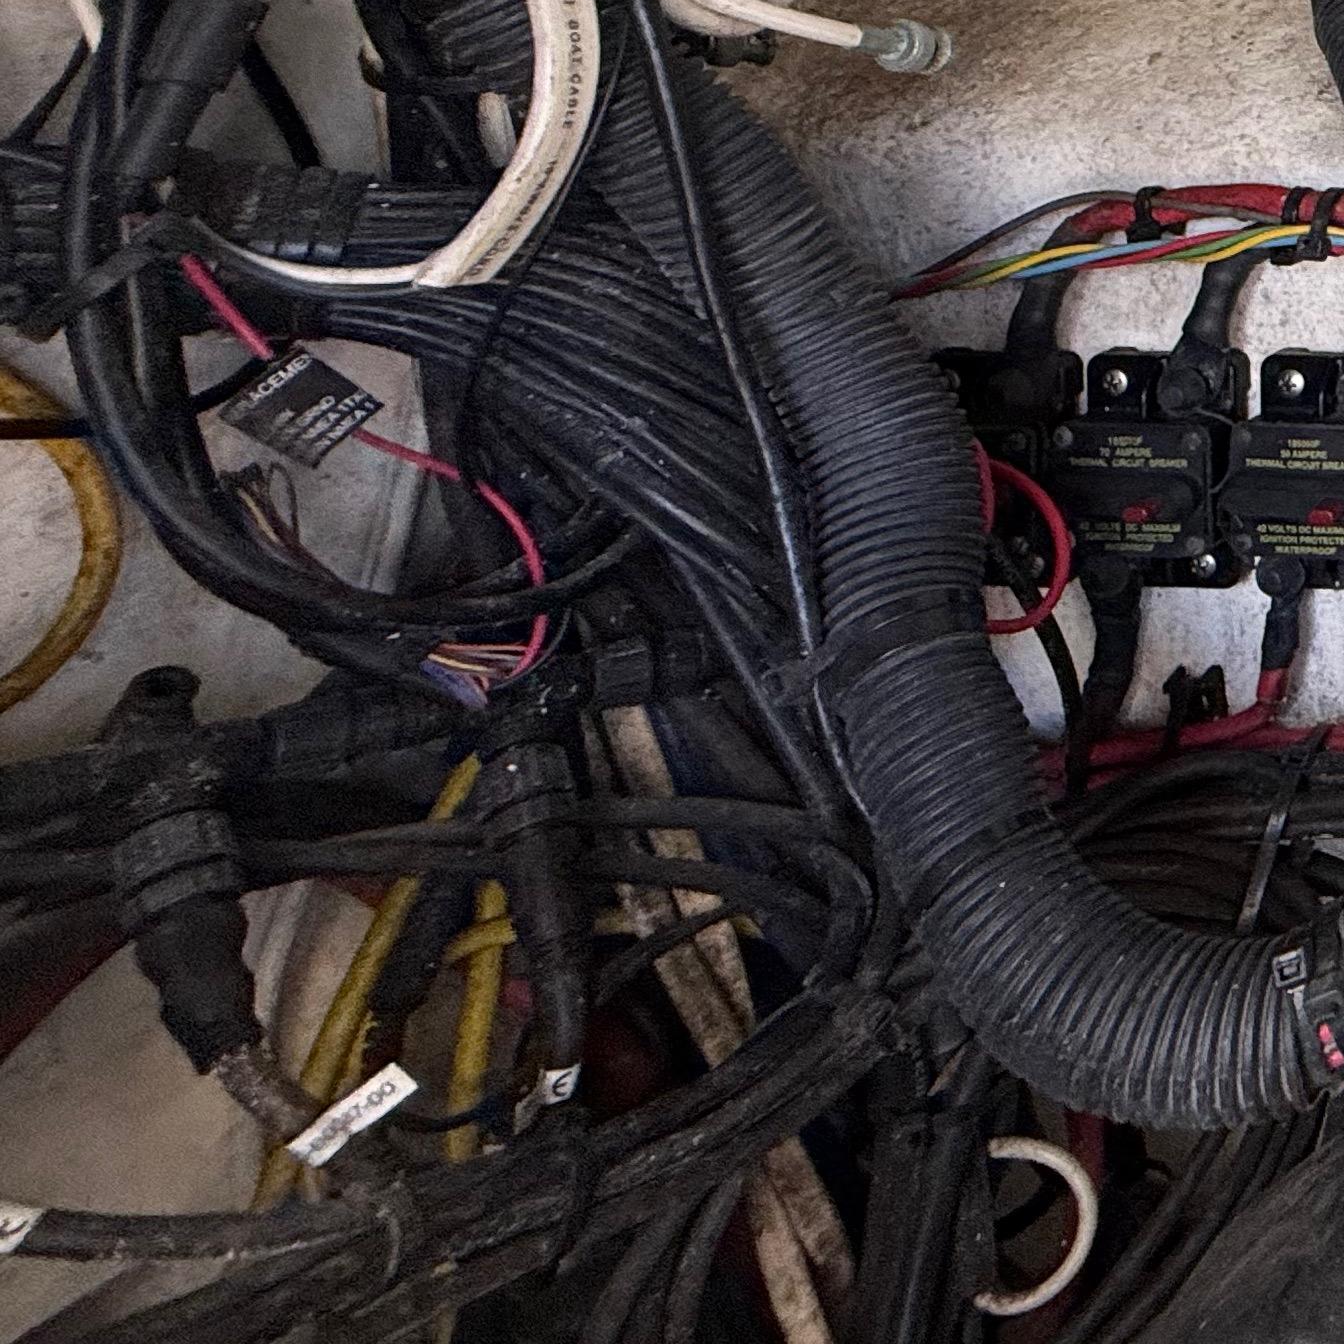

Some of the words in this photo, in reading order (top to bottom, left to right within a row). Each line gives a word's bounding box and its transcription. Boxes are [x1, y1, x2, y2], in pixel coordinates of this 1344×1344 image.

[568, 19, 582, 65] BOAT
[563, 73, 583, 130] CABLE
[1292, 450, 1328, 460] AMPERE
[1245, 458, 1286, 469] THERMAL
[1287, 459, 1320, 470] CIRCUIT
[1268, 524, 1297, 534] VOLTS
[1299, 525, 1312, 534] DC
[1260, 535, 1298, 545] IGNITION
[1274, 545, 1337, 555] WATERPROOF
